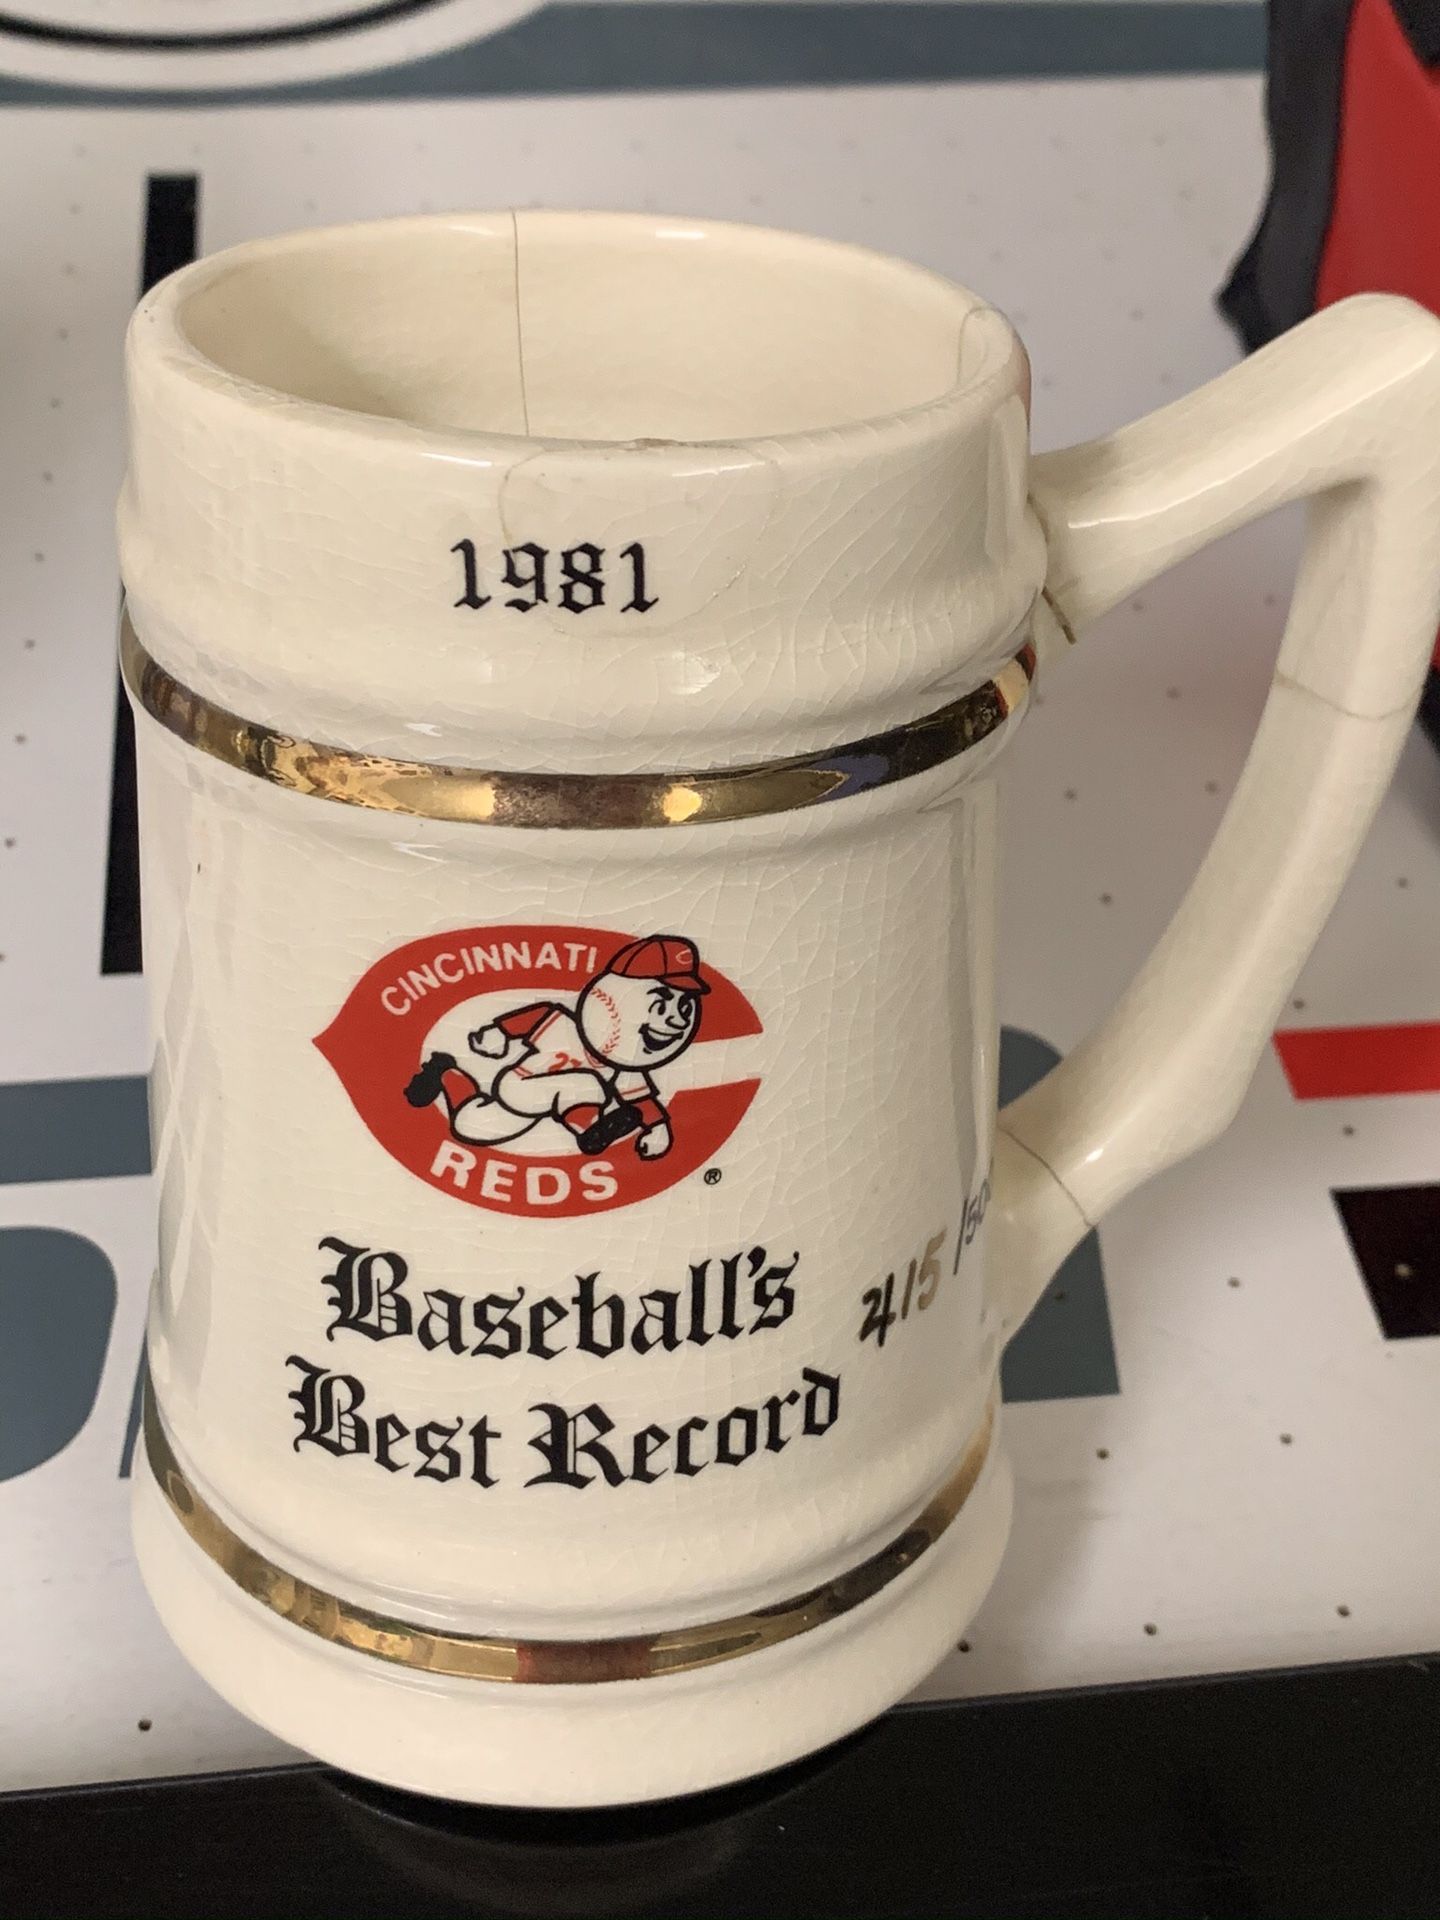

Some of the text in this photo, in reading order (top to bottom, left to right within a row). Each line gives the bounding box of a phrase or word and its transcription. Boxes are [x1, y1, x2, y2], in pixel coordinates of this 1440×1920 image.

[450, 538, 659, 614] 1981
[380, 941, 597, 1016] CINCINNATI
[429, 1139, 619, 1206] REDS
[317, 1236, 800, 1360] Baseball's
[284, 1354, 842, 1490] Best Record
